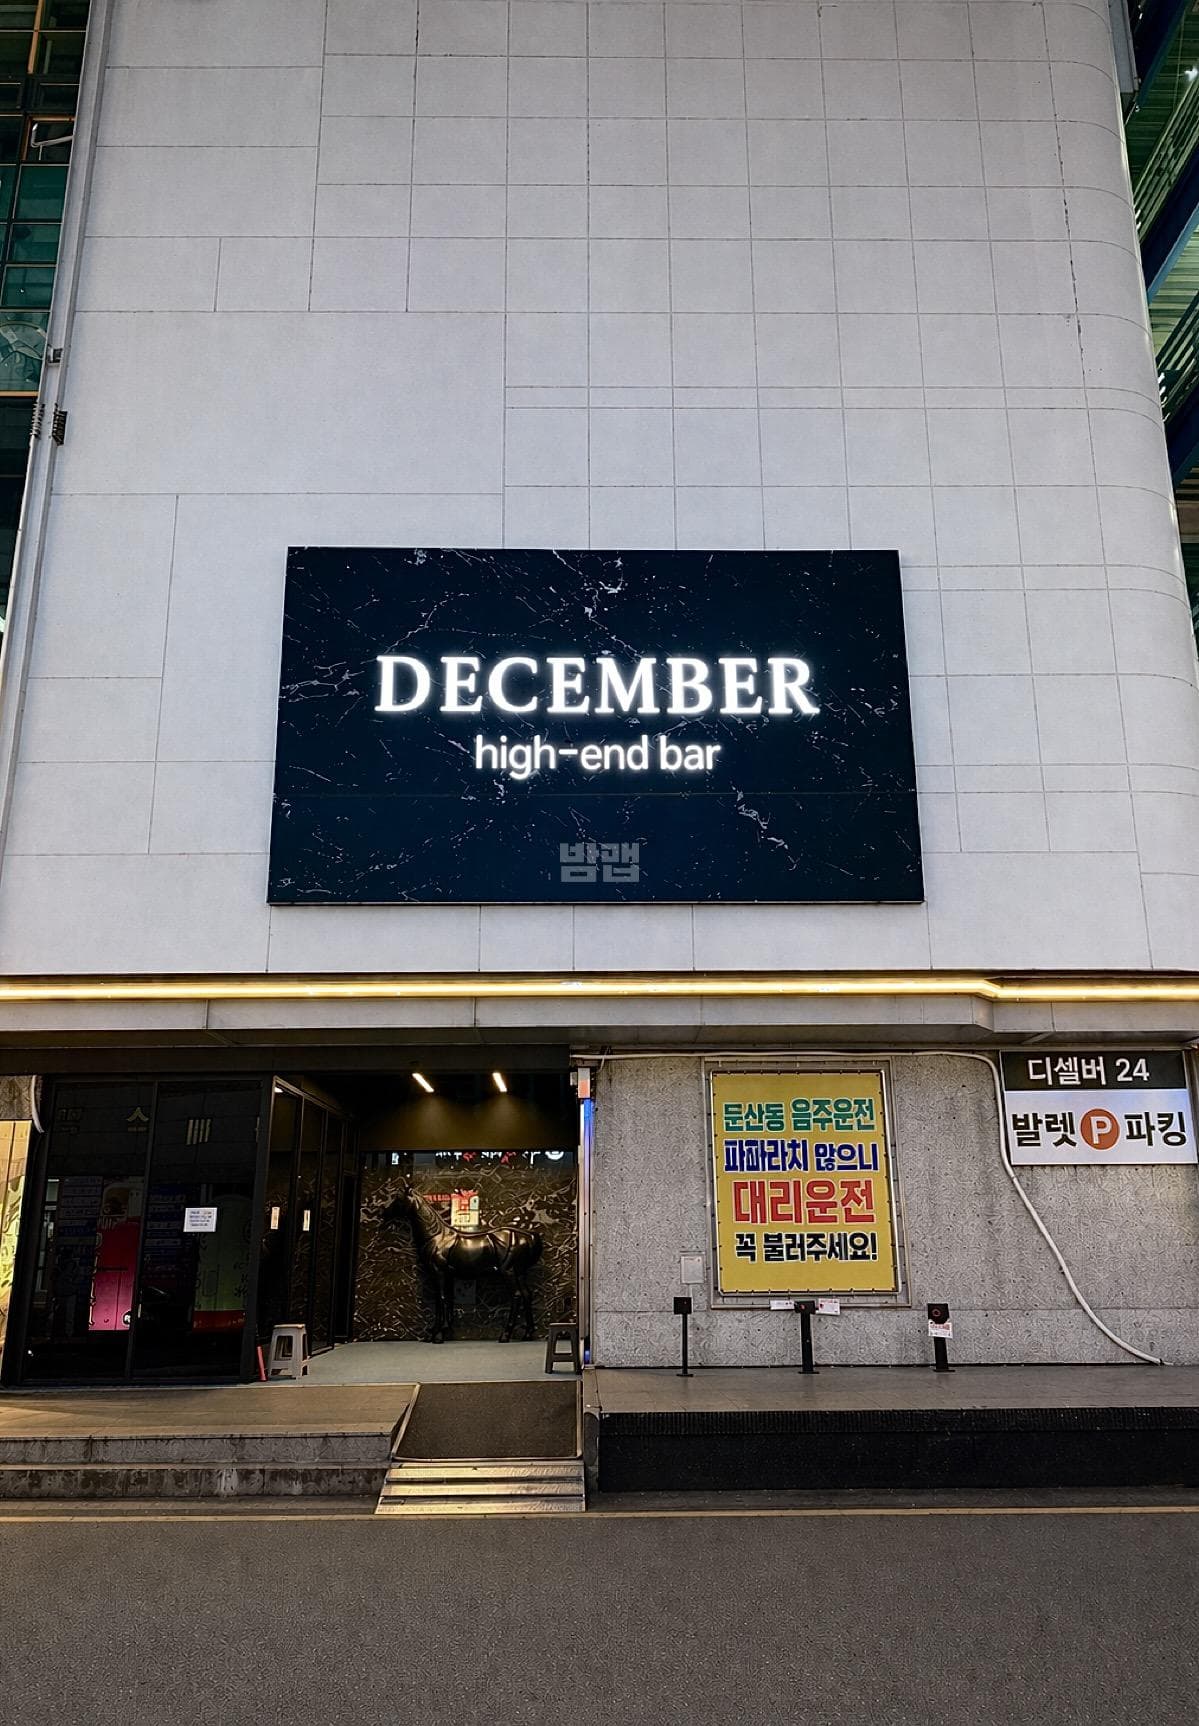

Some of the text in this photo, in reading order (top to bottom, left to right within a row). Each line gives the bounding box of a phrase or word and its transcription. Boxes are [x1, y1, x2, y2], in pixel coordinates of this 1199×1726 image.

[374, 654, 821, 715] DECEMBER
[475, 735, 721, 780] high-end bar
[1028, 1056, 1150, 1086] 디셀버 24
[723, 1098, 876, 1132] 둔산동 음주운전
[1011, 1111, 1187, 1148] 발렛 P 파킹
[724, 1139, 879, 1172] 파파라치 많으니
[733, 1179, 876, 1225] 대리운전
[735, 1232, 878, 1262] 꼭 불러주세요!
